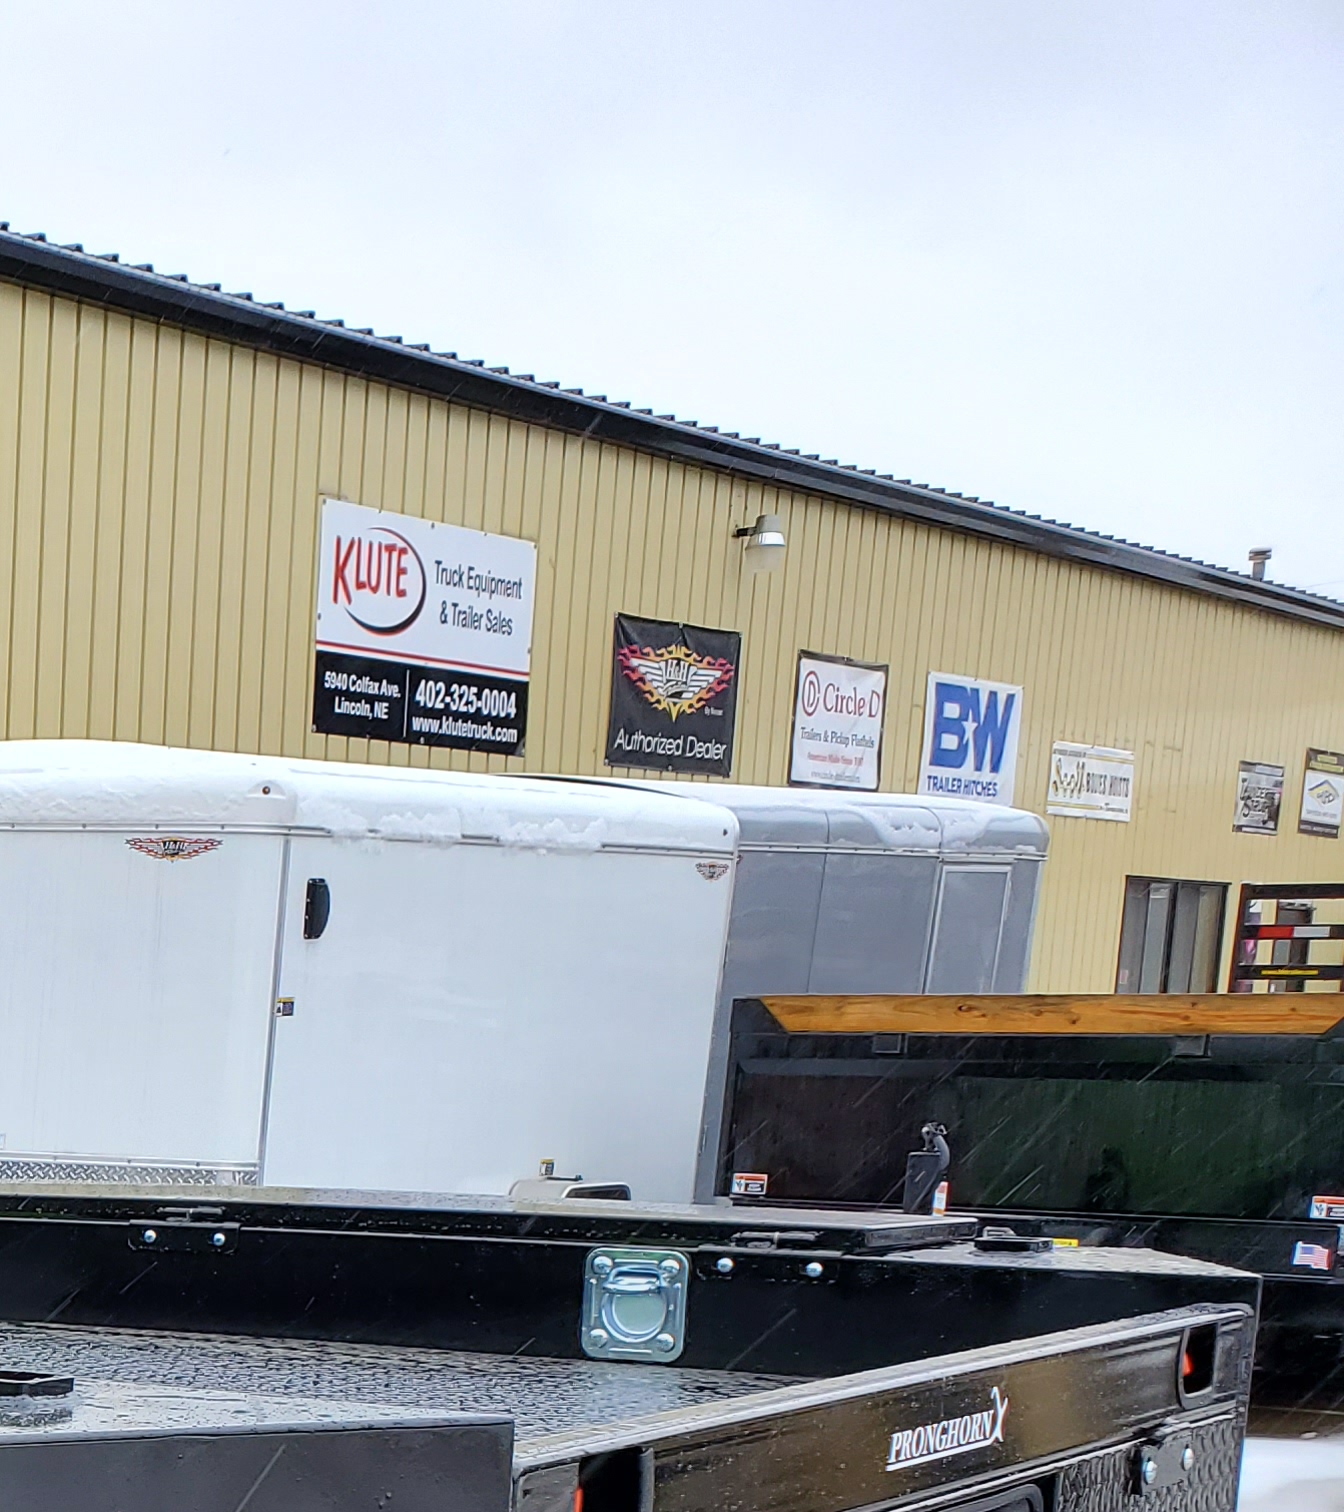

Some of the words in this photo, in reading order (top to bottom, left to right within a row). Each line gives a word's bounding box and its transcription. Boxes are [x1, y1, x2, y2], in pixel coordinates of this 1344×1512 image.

[332, 535, 409, 606] KLUTE
[434, 560, 465, 590] Truck
[467, 566, 522, 600] Equipment
[440, 600, 448, 625] &
[452, 603, 484, 632] Trailer
[485, 608, 513, 636] Sales
[324, 671, 348, 691] 5940
[349, 674, 380, 695] Colfax
[380, 679, 401, 698] Ave.
[415, 679, 516, 718] 402-325-0004
[823, 682, 866, 717] Circle
[868, 689, 880, 718] D
[334, 696, 372, 720] Lincoln,
[374, 702, 389, 720] NE
[412, 715, 518, 743] www.klutetruck.com
[614, 727, 684, 756] Authorized
[685, 736, 727, 760] Dealer
[927, 775, 962, 794] TRAILER
[962, 778, 998, 798] HITCHES
[887, 1410, 994, 1463] PRONGHORN
